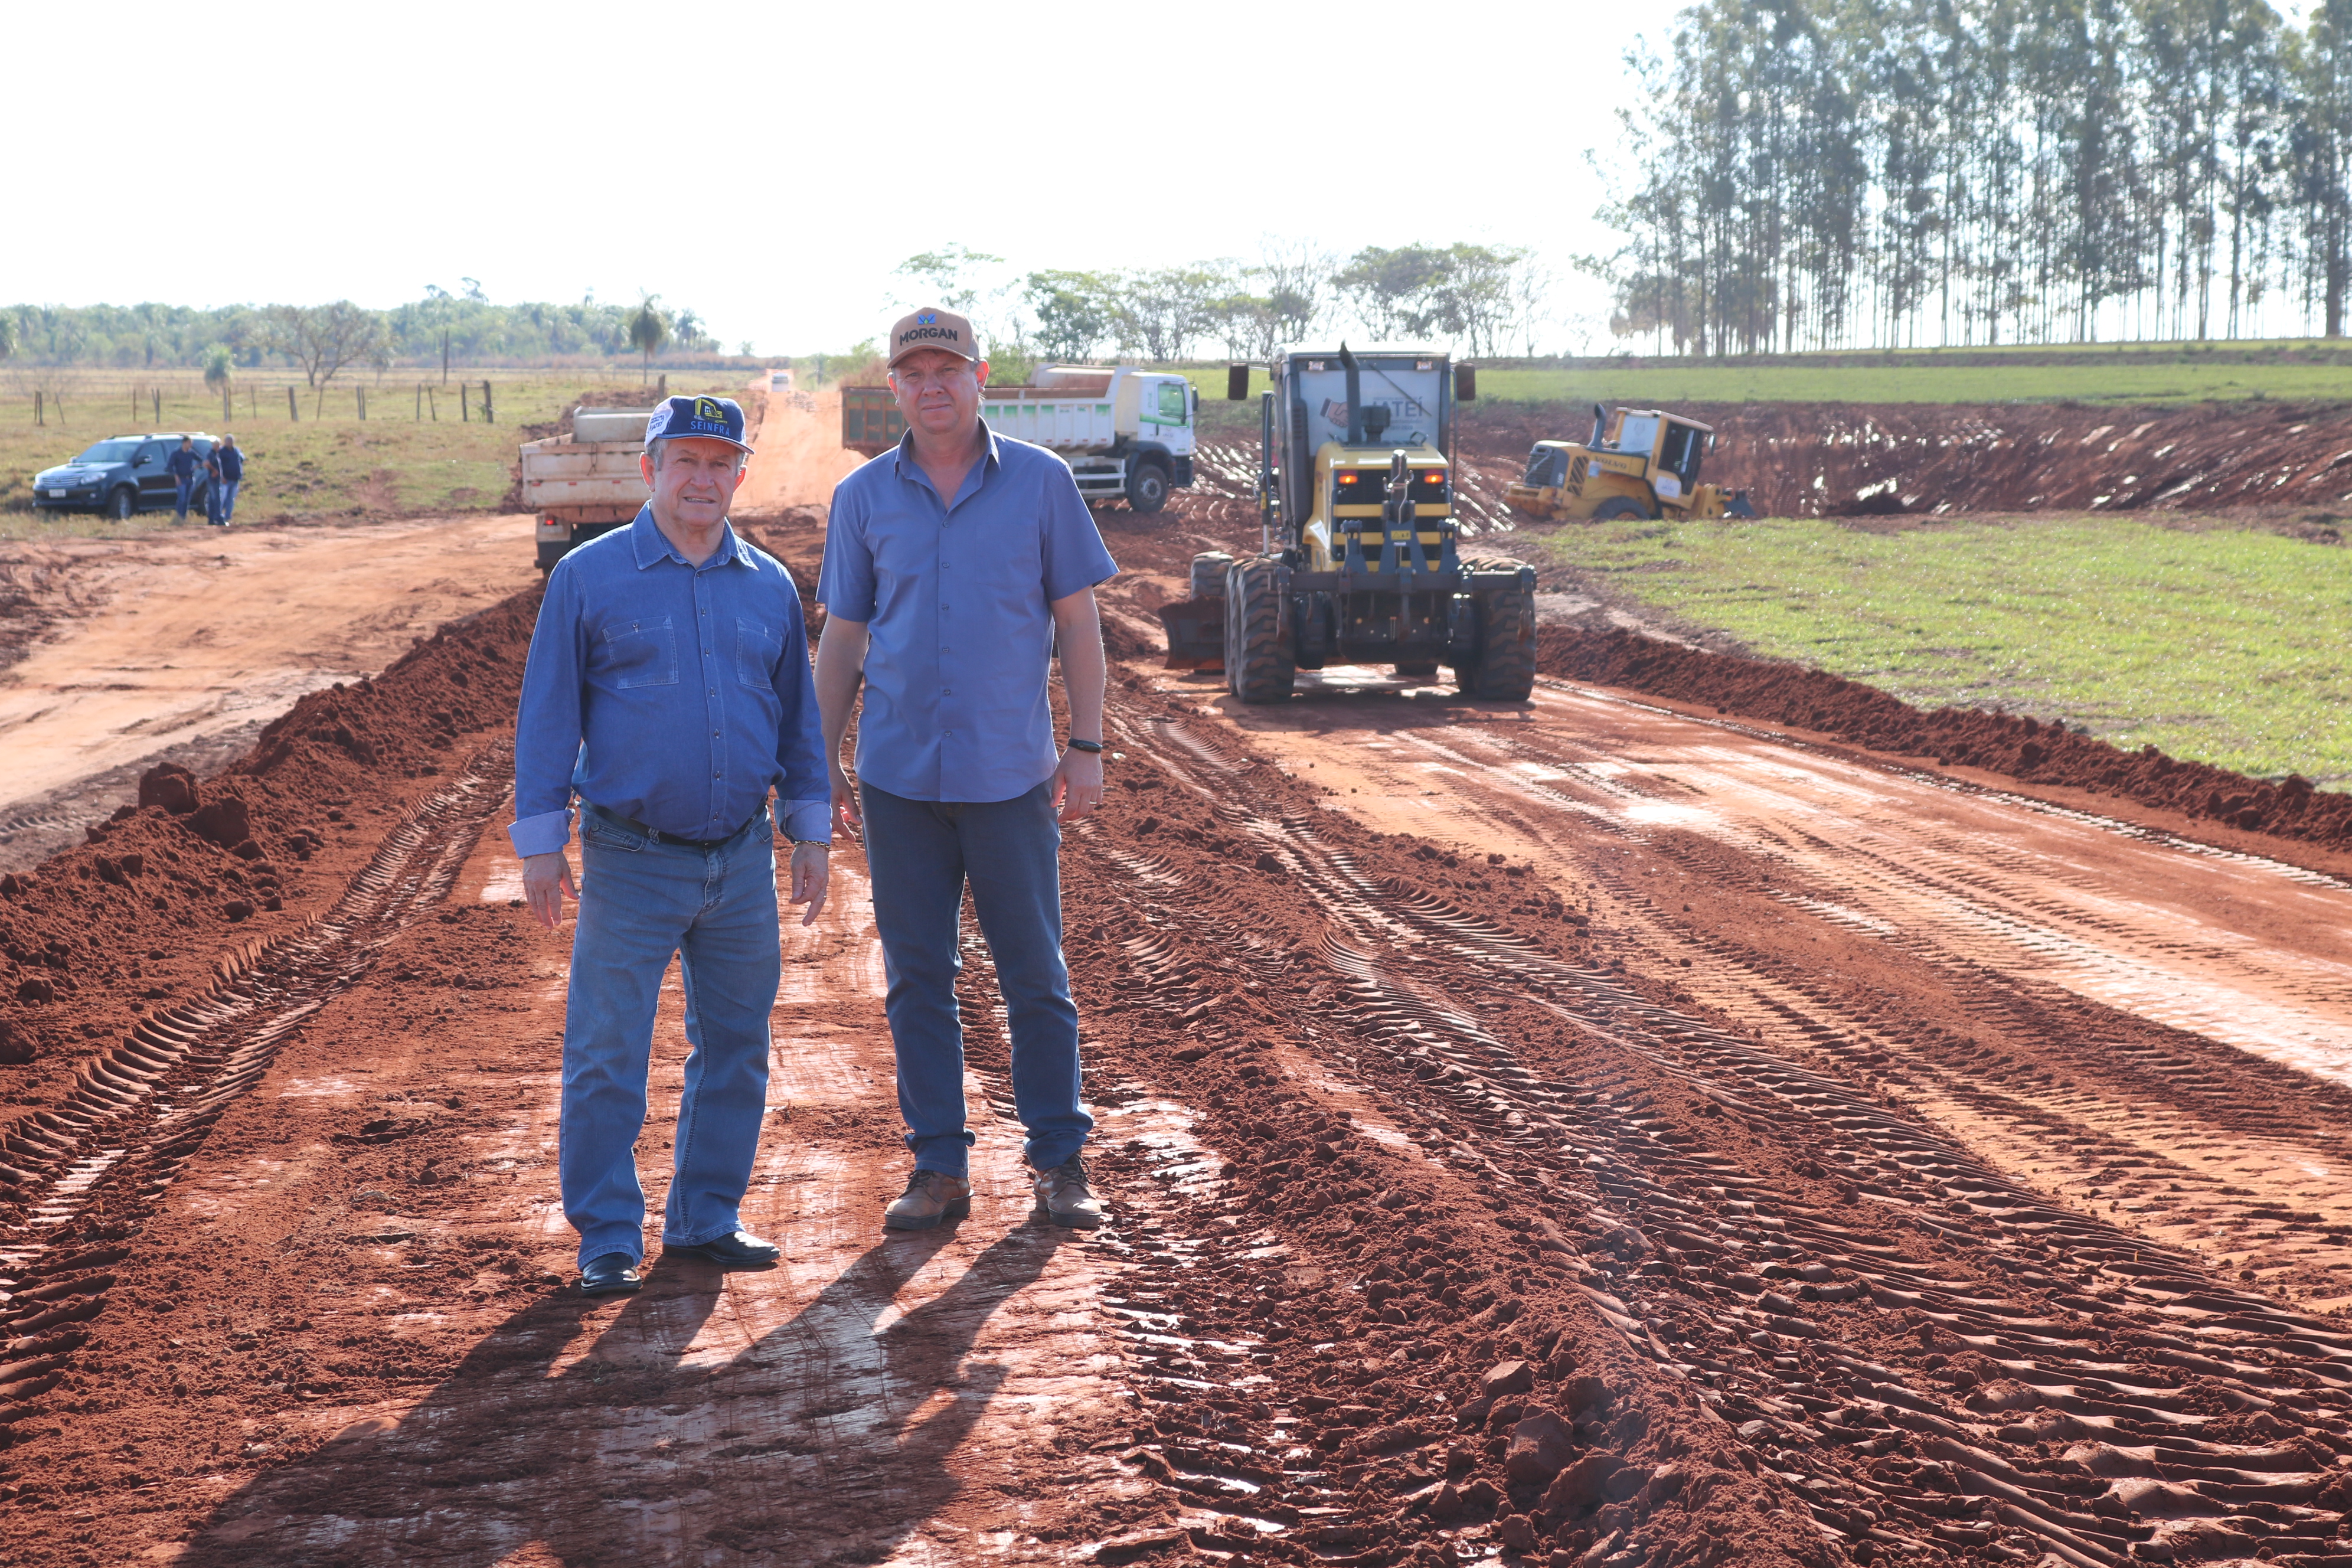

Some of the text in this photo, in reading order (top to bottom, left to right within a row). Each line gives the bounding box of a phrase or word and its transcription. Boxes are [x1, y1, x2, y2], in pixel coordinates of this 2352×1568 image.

[900, 328, 957, 345] MORGAN
[691, 421, 730, 436] SEINFRA
[1595, 456, 1627, 469] VOLVO
